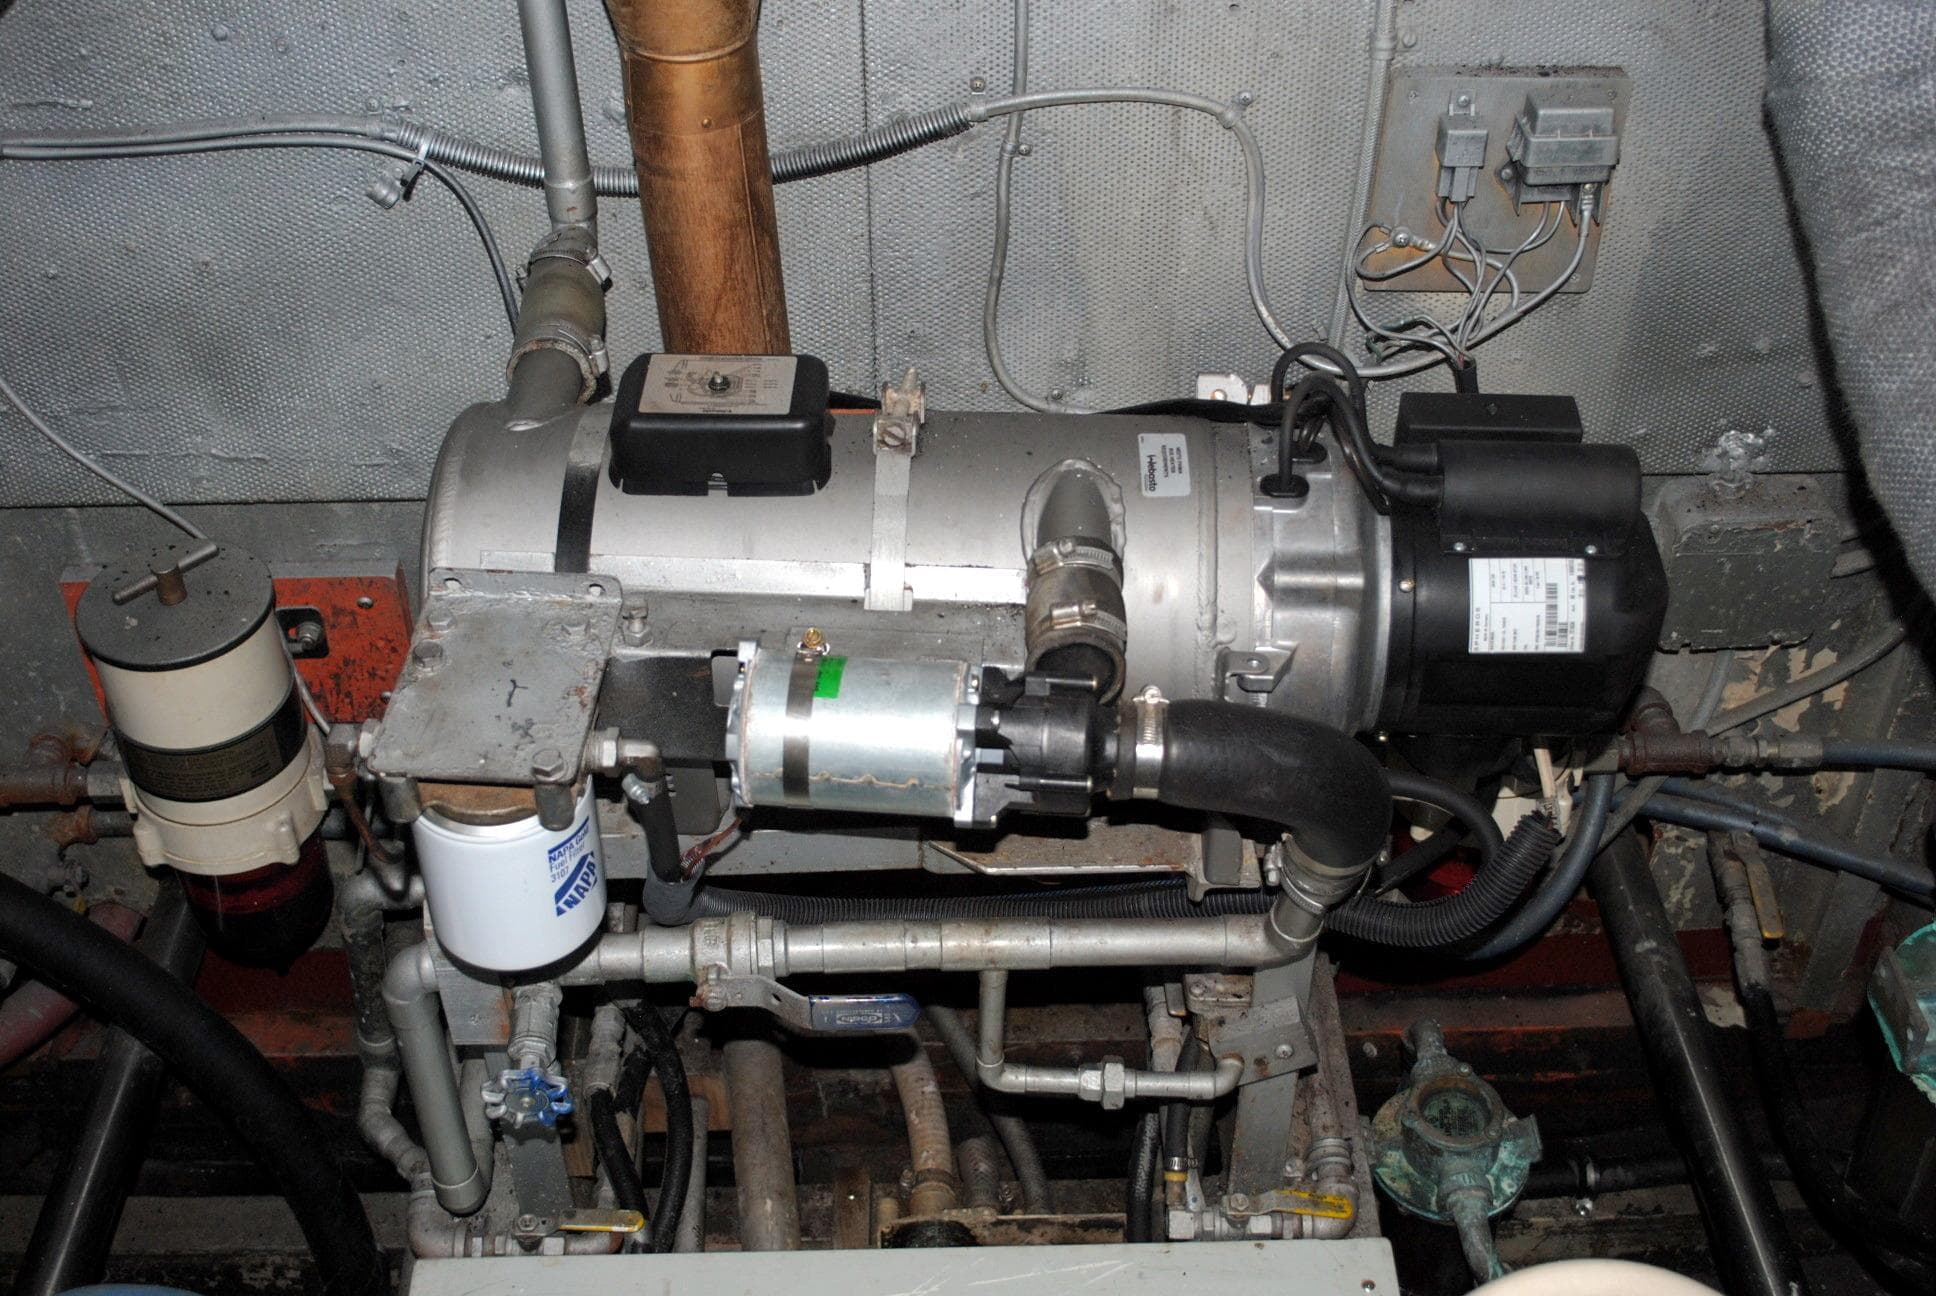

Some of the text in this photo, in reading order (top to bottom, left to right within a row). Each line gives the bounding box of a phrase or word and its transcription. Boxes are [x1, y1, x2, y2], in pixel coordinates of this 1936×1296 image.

[1146, 454, 1158, 492] Webasto
[548, 825, 589, 863] NAPA Gold
[550, 841, 585, 872] Fuel Filter
[550, 866, 569, 883] 3107
[563, 860, 596, 909] NAPA
